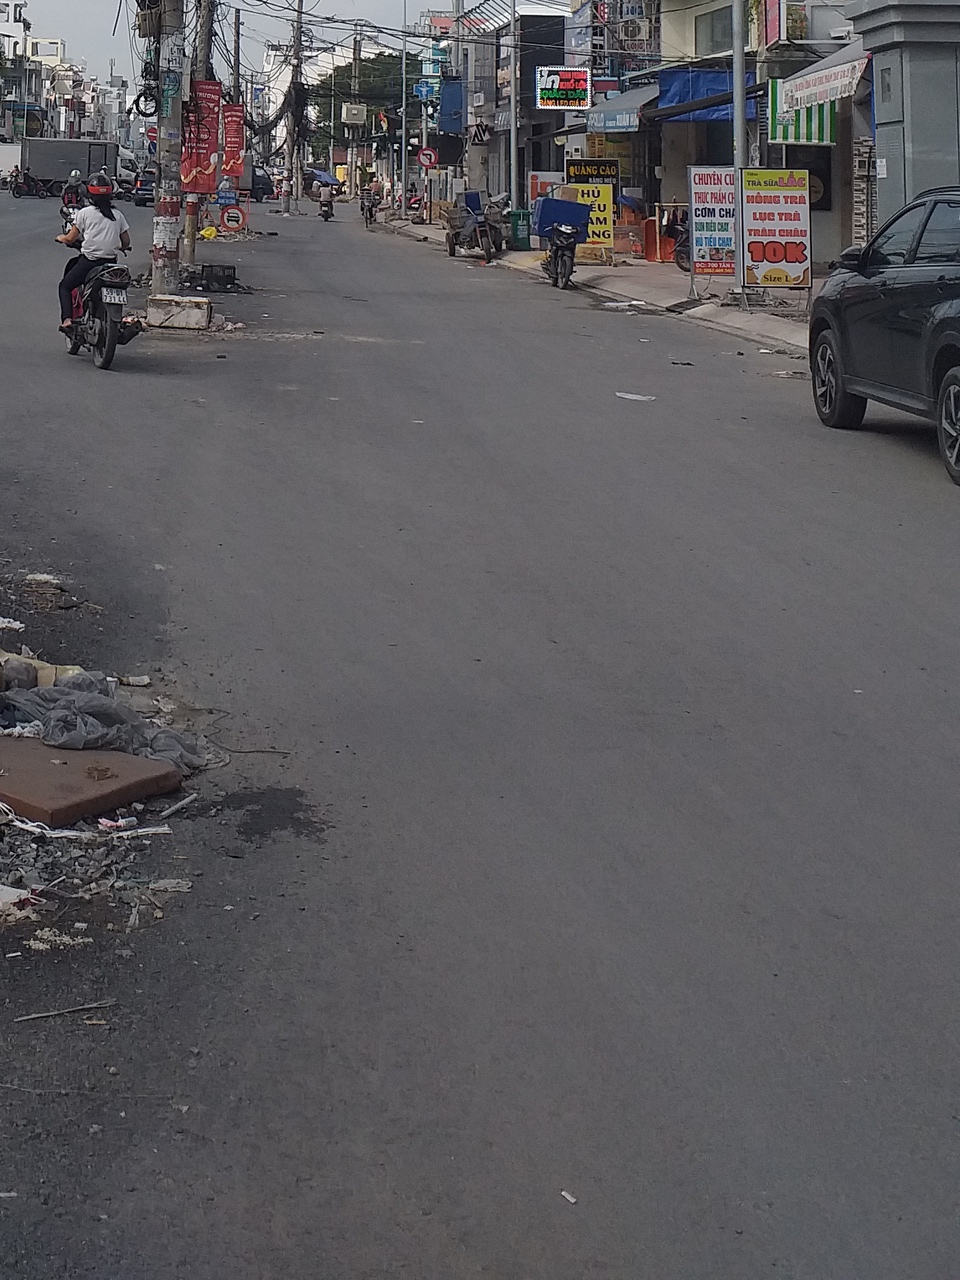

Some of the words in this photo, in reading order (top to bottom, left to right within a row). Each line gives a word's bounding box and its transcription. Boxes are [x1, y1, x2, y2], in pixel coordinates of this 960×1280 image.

[569, 163, 598, 176] QUẢNG
[600, 164, 616, 175] CÁO
[693, 171, 722, 185] CHUYÊN
[725, 173, 734, 185] CU
[747, 178, 761, 186] TRÀ
[763, 178, 779, 187] SỮA
[581, 186, 600, 198] HỦ
[694, 191, 709, 206] THỰC
[783, 194, 806, 205] TRÀ
[590, 200, 606, 212] ẾU
[694, 207, 716, 218] CƠM
[719, 208, 735, 218] CHA
[752, 212, 775, 223] LỤC
[777, 210, 801, 221] TRÀ
[588, 217, 607, 225] AM
[747, 227, 776, 237] TRÂN
[778, 228, 807, 237] CHÂU
[718, 237, 732, 247] CHAY
[748, 241, 808, 264] 10K
[763, 275, 782, 283] Size
[784, 275, 791, 283] L
